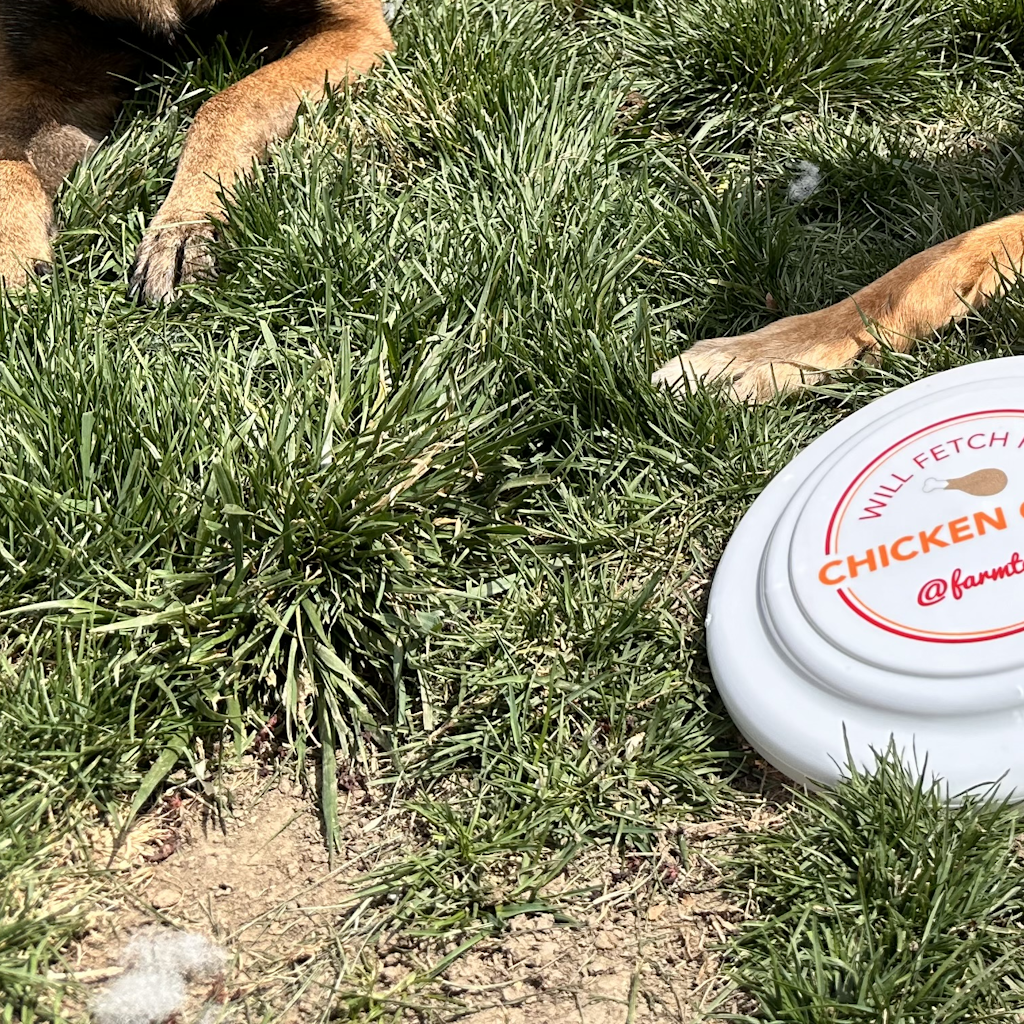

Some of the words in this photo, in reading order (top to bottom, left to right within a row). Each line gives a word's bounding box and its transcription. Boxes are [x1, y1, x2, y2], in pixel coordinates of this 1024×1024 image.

[858, 470, 914, 520] WILL
[912, 431, 1010, 470] FETCH
[818, 507, 1008, 586] CHICKEN
